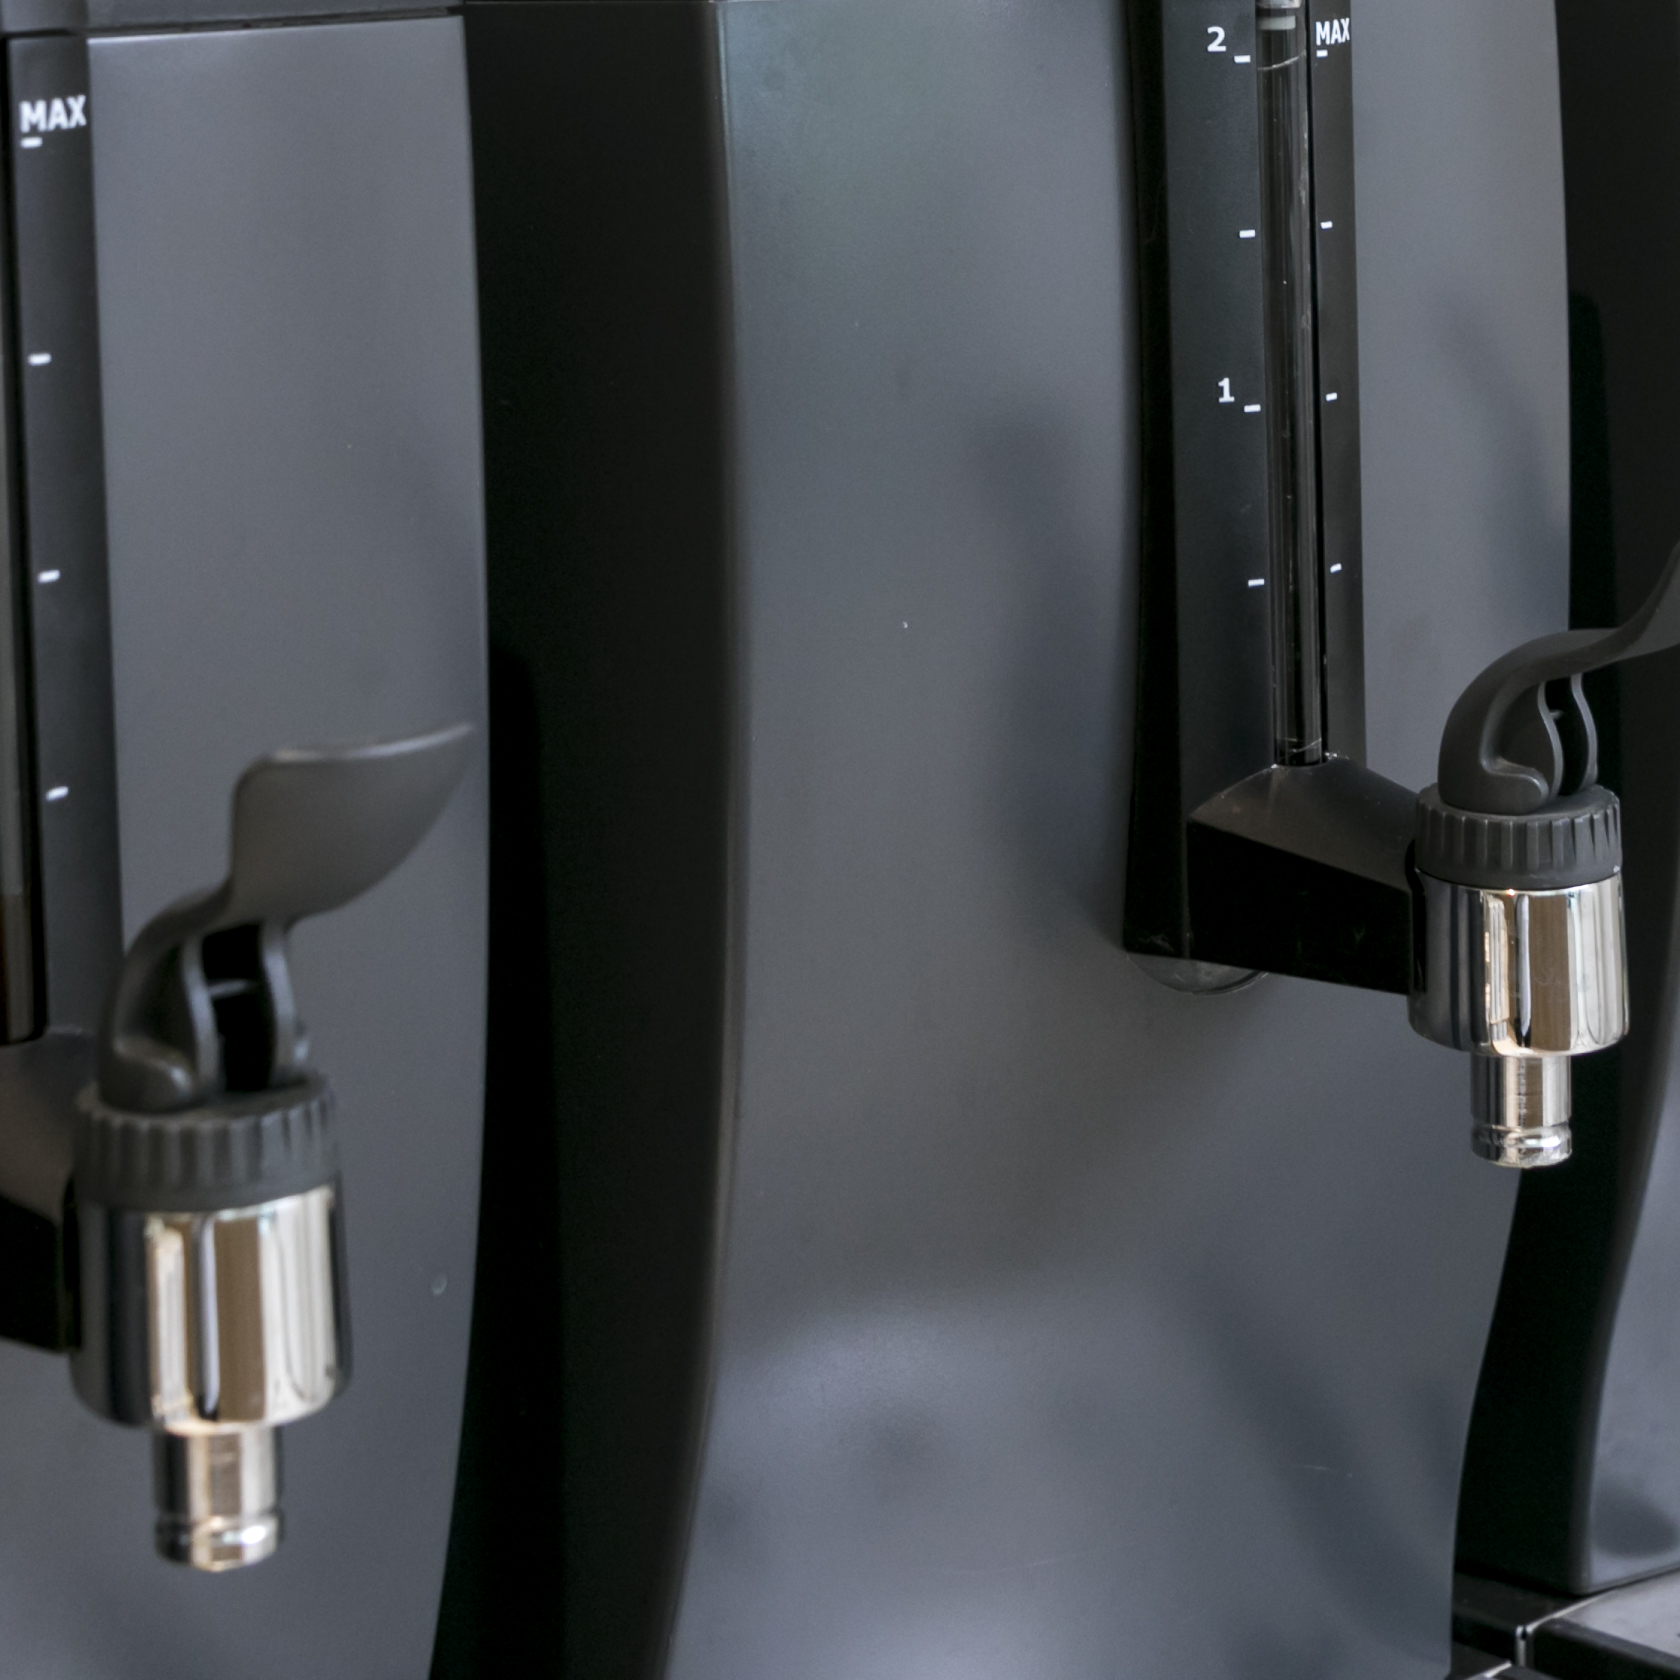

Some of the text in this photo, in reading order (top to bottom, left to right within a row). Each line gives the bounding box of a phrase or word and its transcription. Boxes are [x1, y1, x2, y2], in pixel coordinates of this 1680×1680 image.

[1206, 25, 1228, 53] 2
[1315, 17, 1350, 46] MAX
[18, 93, 88, 132] MAX
[1217, 376, 1236, 404] 1
